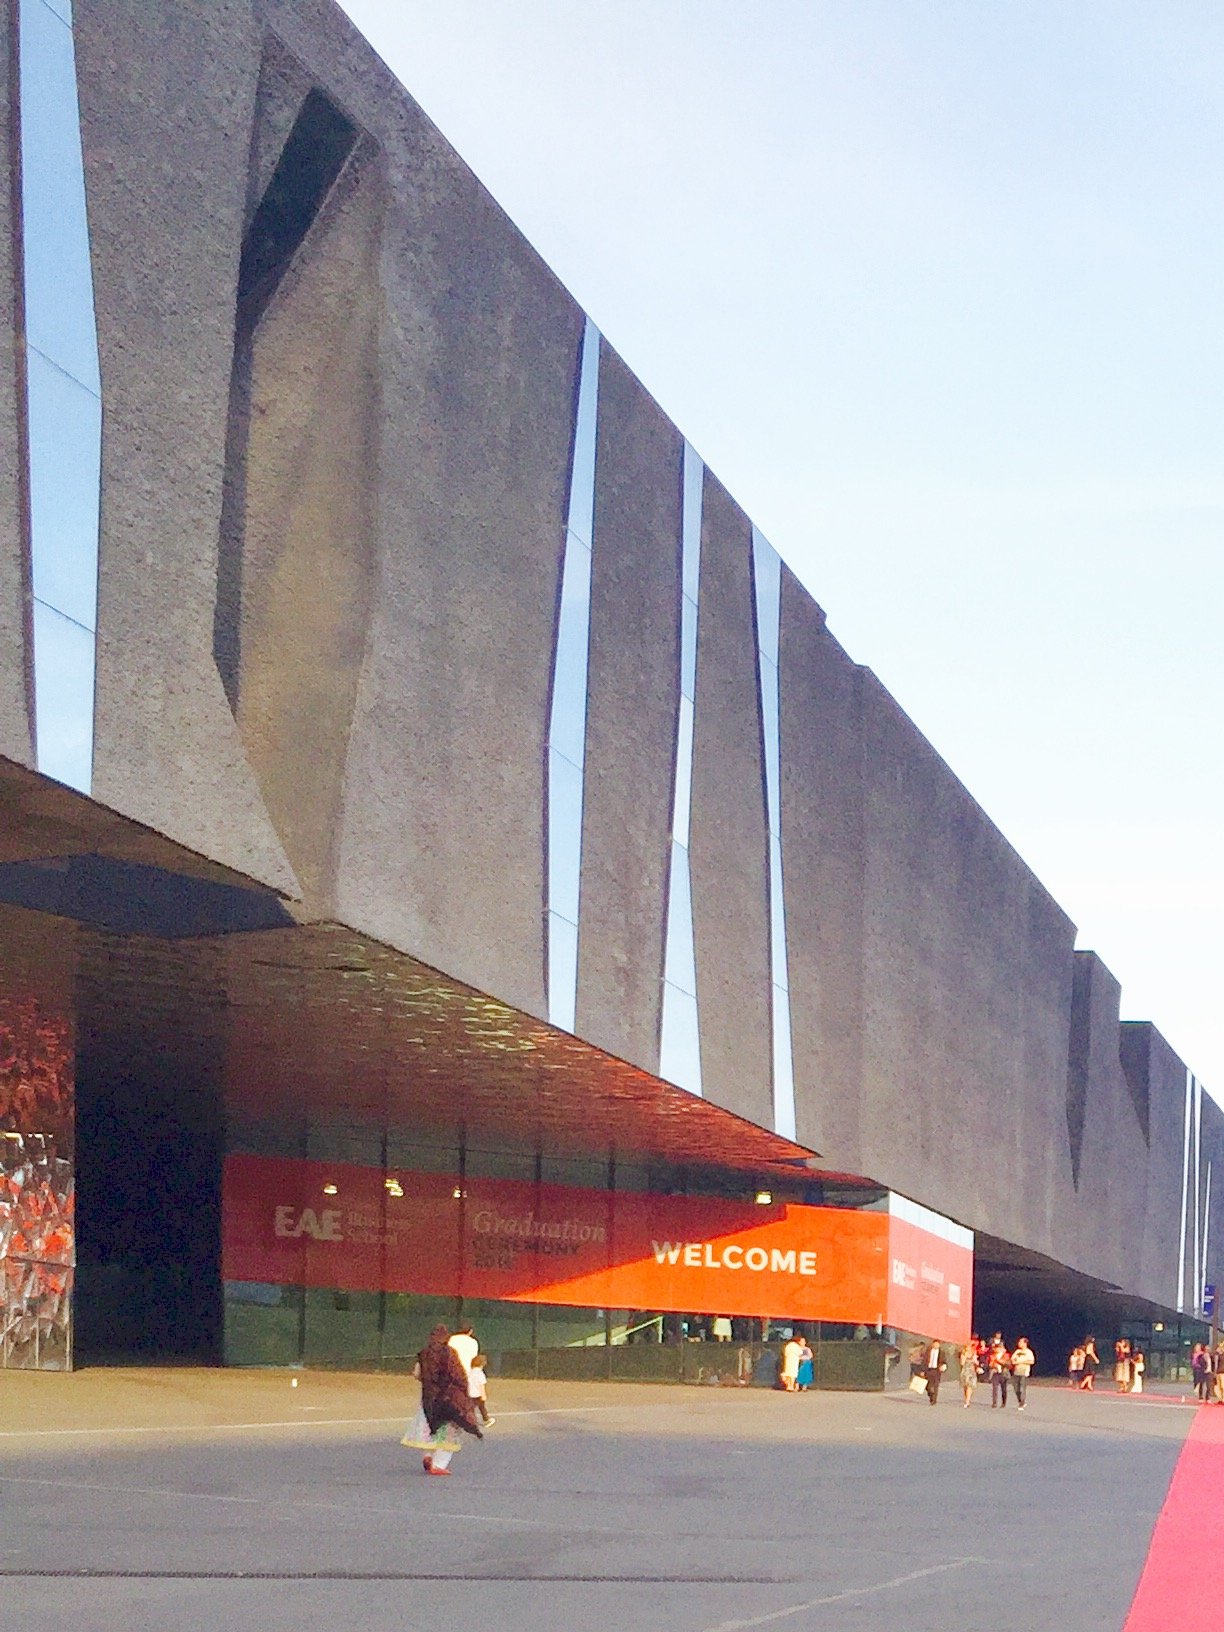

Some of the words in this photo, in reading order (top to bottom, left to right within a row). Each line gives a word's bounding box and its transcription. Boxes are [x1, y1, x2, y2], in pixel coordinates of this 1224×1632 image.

[274, 1205, 344, 1241] EAE
[473, 1210, 606, 1242] Graduation
[652, 1240, 817, 1275] WELCOME
